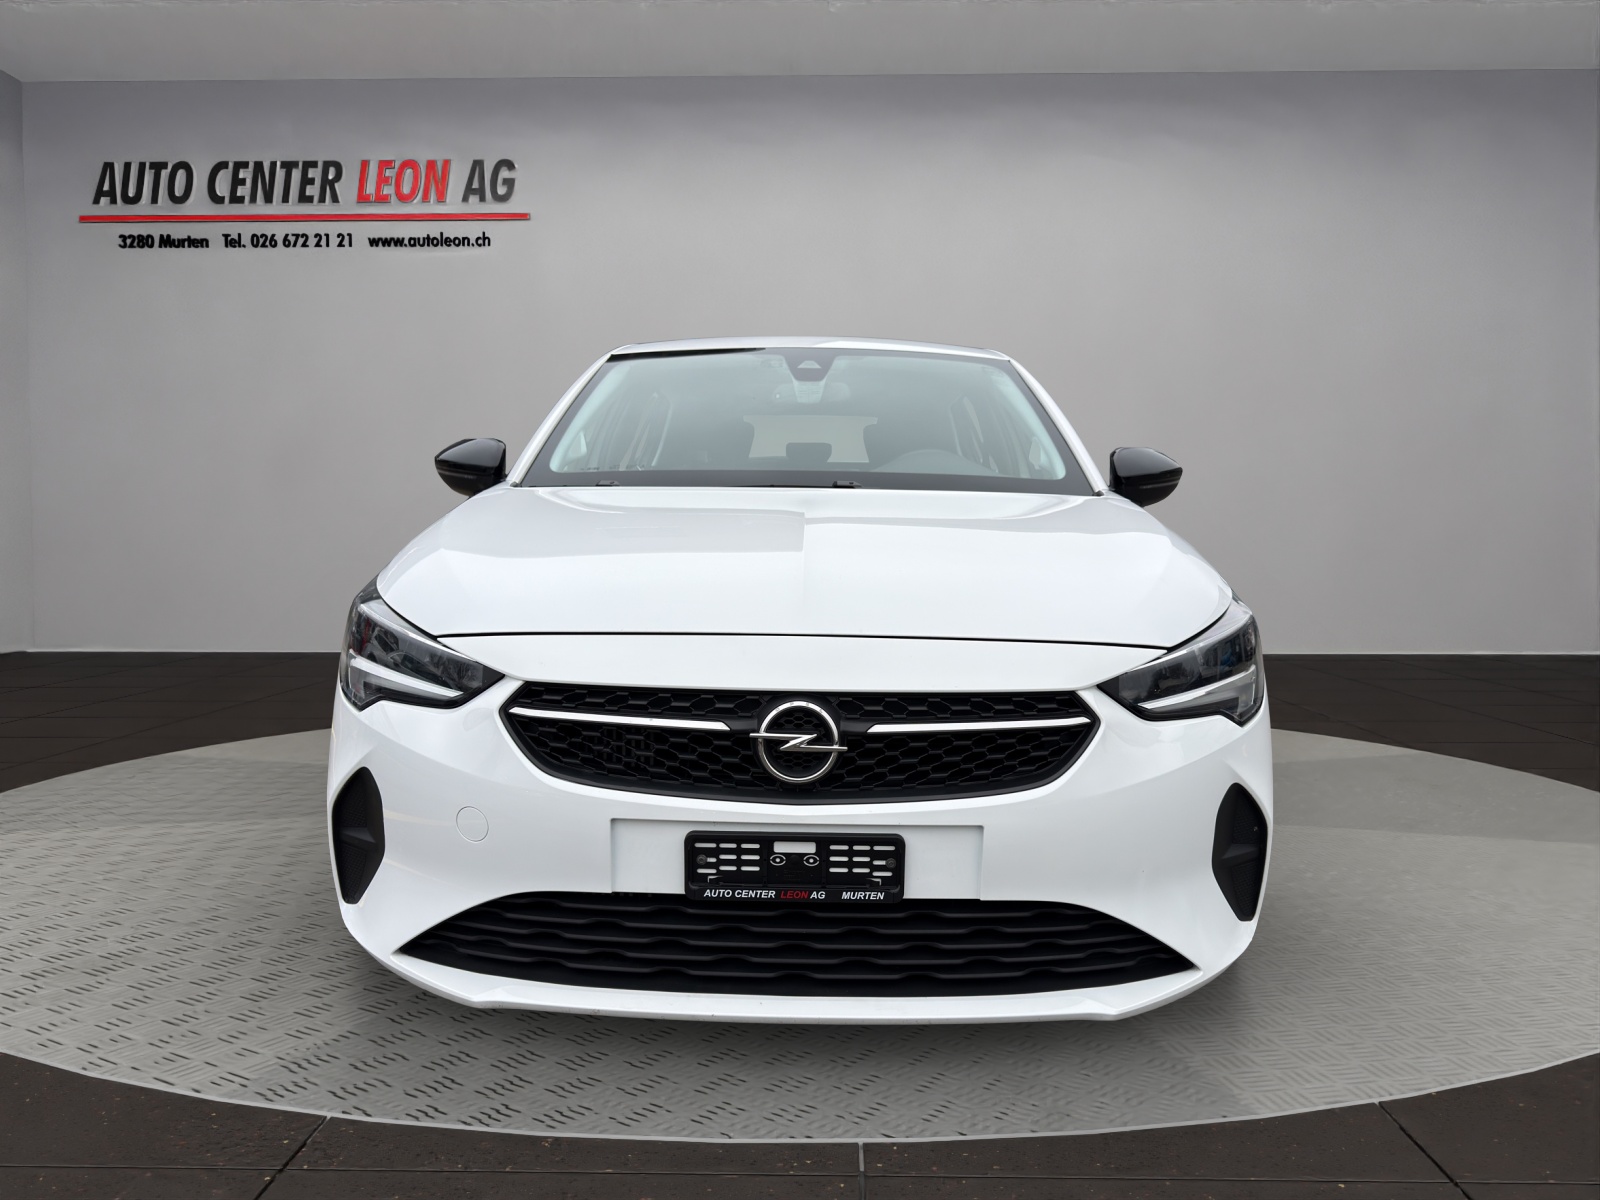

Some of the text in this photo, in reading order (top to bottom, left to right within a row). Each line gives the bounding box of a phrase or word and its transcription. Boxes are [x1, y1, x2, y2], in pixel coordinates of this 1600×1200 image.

[92, 159, 516, 205] AUTO CENTER LEON AG
[118, 231, 491, 249] 3280 Murten Tel. 026 672 21 21 www.autoleon.ch
[703, 889, 885, 901] AUTO CENTER LEON AG MURTEN
